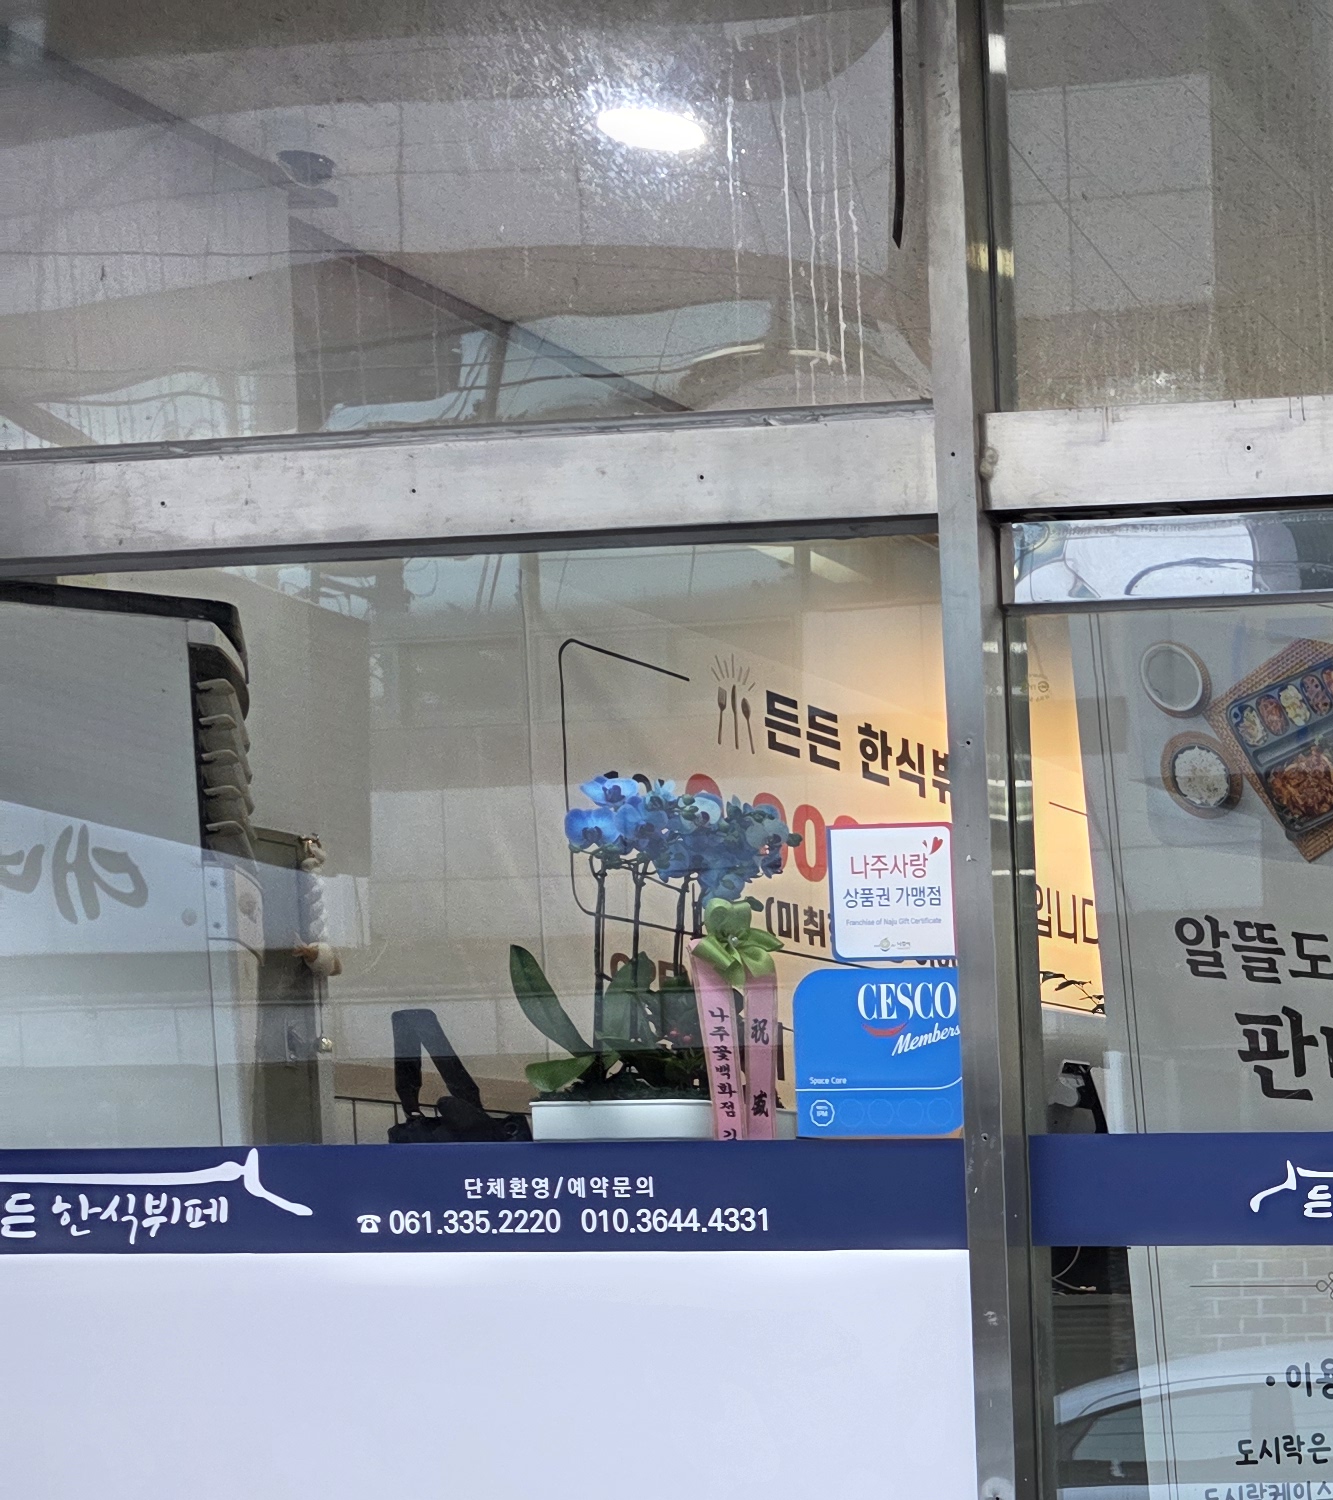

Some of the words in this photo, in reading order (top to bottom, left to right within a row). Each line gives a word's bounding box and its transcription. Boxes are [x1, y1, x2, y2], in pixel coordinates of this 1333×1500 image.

[764, 690, 841, 771] 든든
[850, 852, 929, 880] 나주사랑
[843, 887, 891, 909] 상품권
[895, 885, 942, 908] 가맹점
[765, 896, 833, 948] (미취
[857, 981, 957, 1021] CESCO
[750, 1018, 770, 1046] 祝
[891, 1022, 961, 1057] Members
[708, 1006, 738, 1118] 나주꽃백화점
[809, 1076, 830, 1086] Space
[831, 1076, 848, 1085] Care
[464, 1175, 655, 1199] 단체환영/예약문의
[52, 1193, 229, 1245] 한식뷔페
[389, 1209, 561, 1235] 061.335.2220
[581, 1208, 769, 1233] 010.3644.4331
[1235, 1432, 1332, 1466] 도시락은
